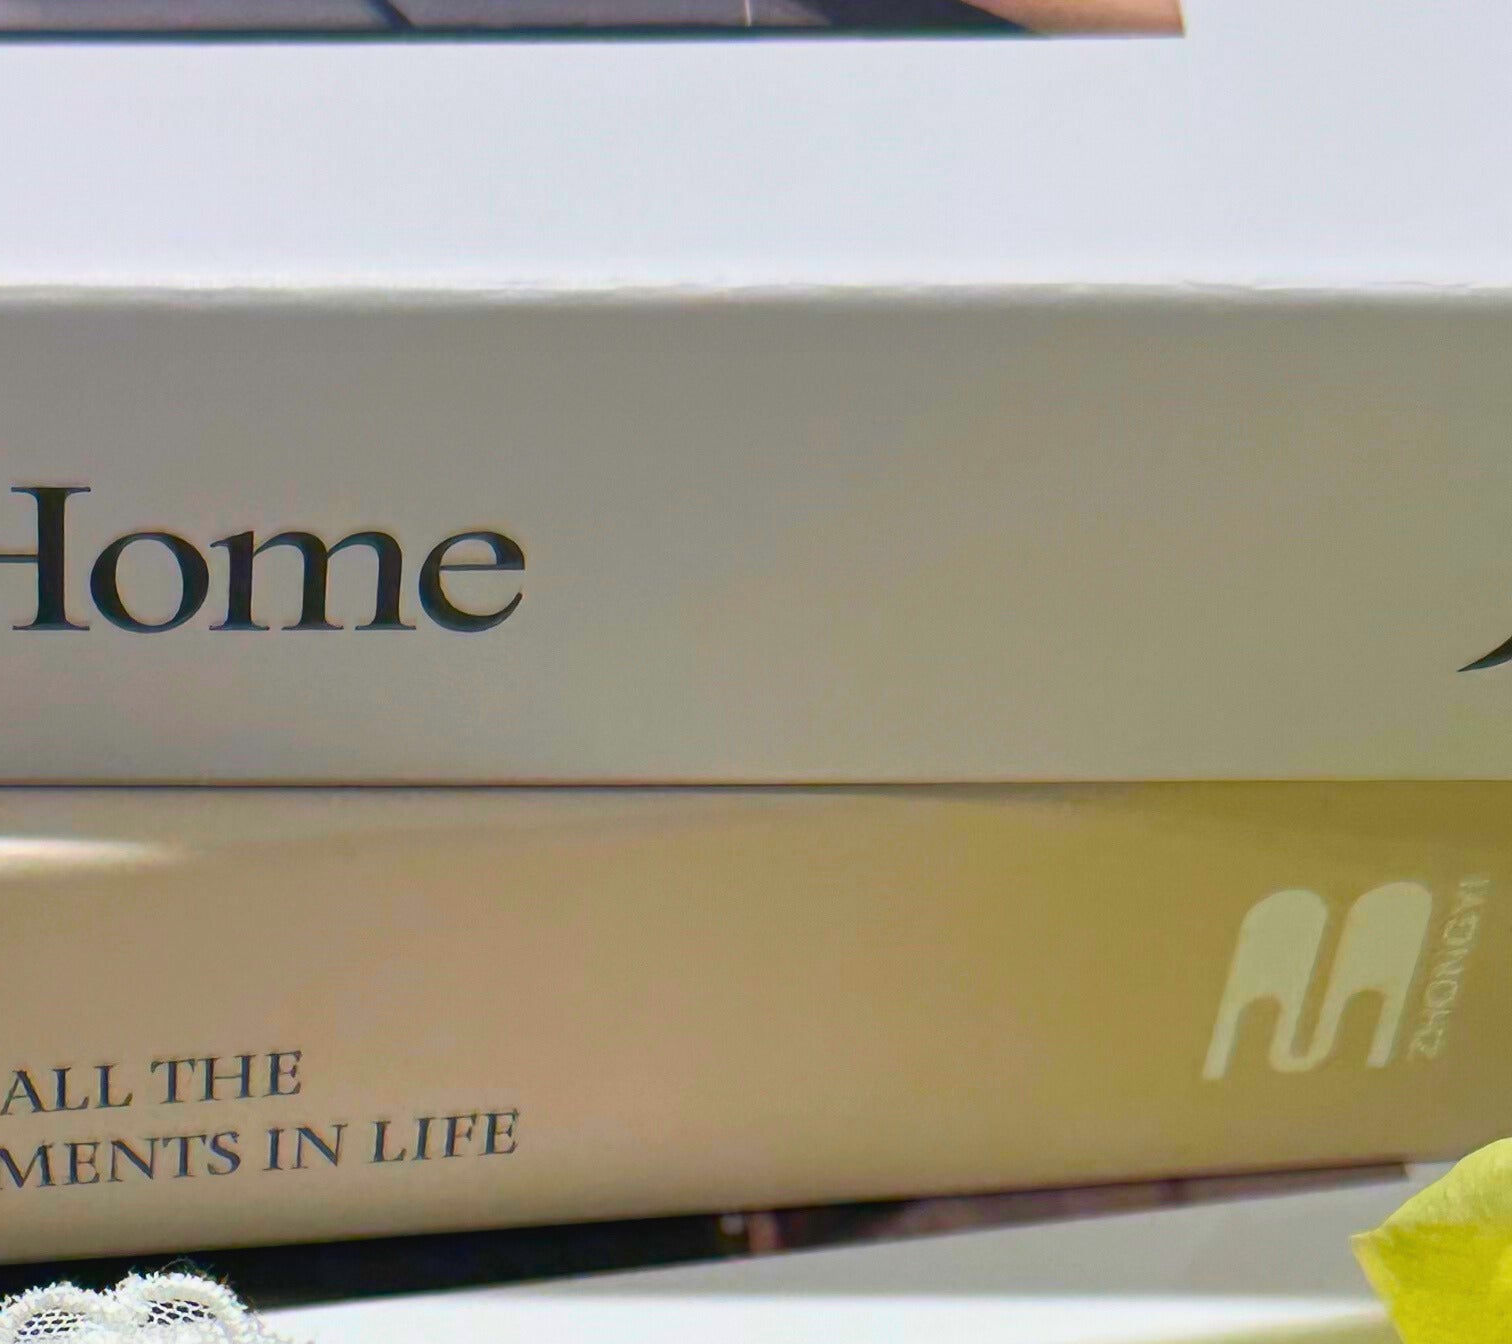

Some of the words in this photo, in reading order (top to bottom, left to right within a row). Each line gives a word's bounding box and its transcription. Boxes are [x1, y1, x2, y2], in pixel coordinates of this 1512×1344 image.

[149, 1049, 303, 1106] THE
[262, 1123, 349, 1172] IN
[369, 1107, 520, 1166] LIFE
